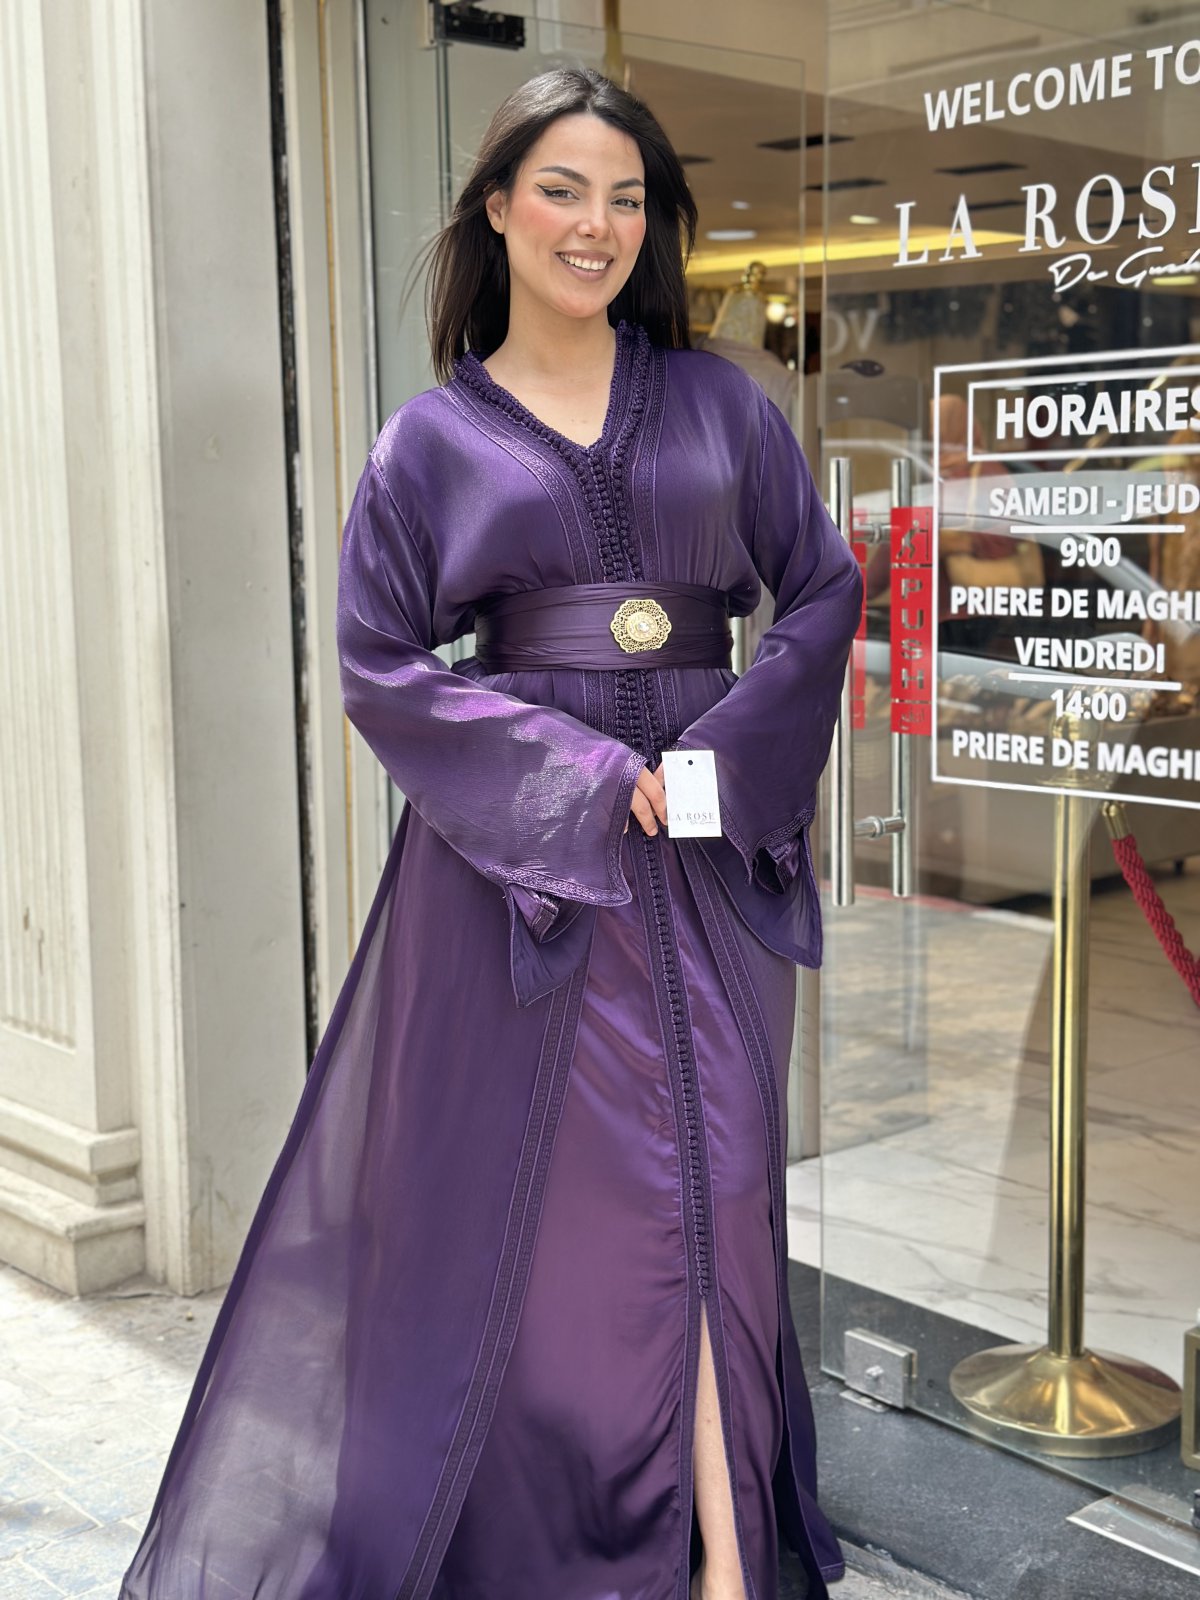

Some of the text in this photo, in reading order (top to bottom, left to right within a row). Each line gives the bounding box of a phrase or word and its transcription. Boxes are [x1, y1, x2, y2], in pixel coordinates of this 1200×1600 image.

[924, 39, 1200, 131] WELCOME TO
[893, 194, 982, 267] LA
[1048, 253, 1108, 292] De
[989, 485, 1098, 517] SAMEDI
[1120, 483, 1200, 522] JEUD
[1060, 537, 1121, 567] 9:00
[951, 586, 1200, 621] PRIERE DE MAGH
[901, 578, 924, 690] PUSH
[1014, 637, 1165, 674] VENDREDI
[1051, 689, 1127, 722] 14:00
[952, 729, 1200, 781] PRIERE DE MAGH
